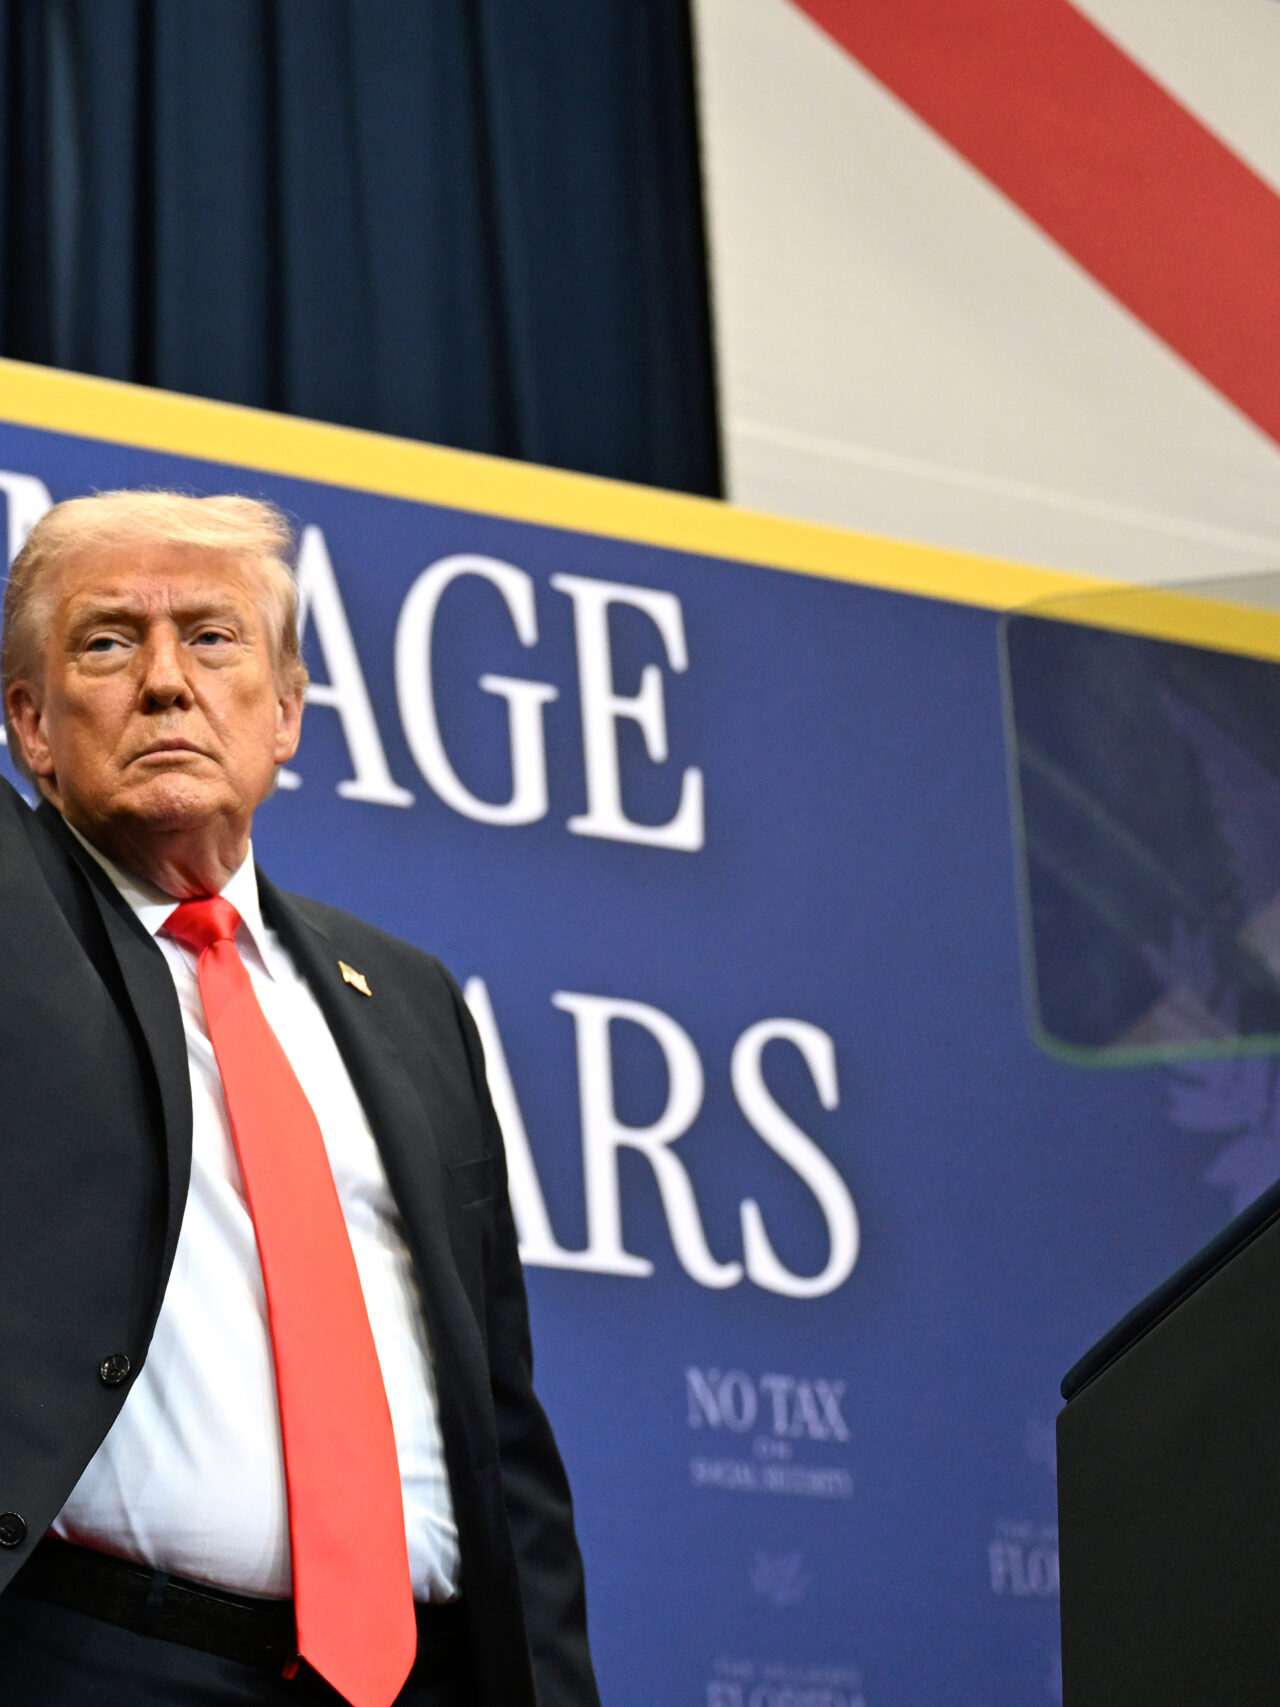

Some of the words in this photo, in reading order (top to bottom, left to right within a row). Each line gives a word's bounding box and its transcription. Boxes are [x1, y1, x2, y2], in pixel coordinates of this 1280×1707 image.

[277, 523, 705, 852] AGE
[686, 1365, 756, 1432] NO
[761, 1373, 851, 1441] TAX
